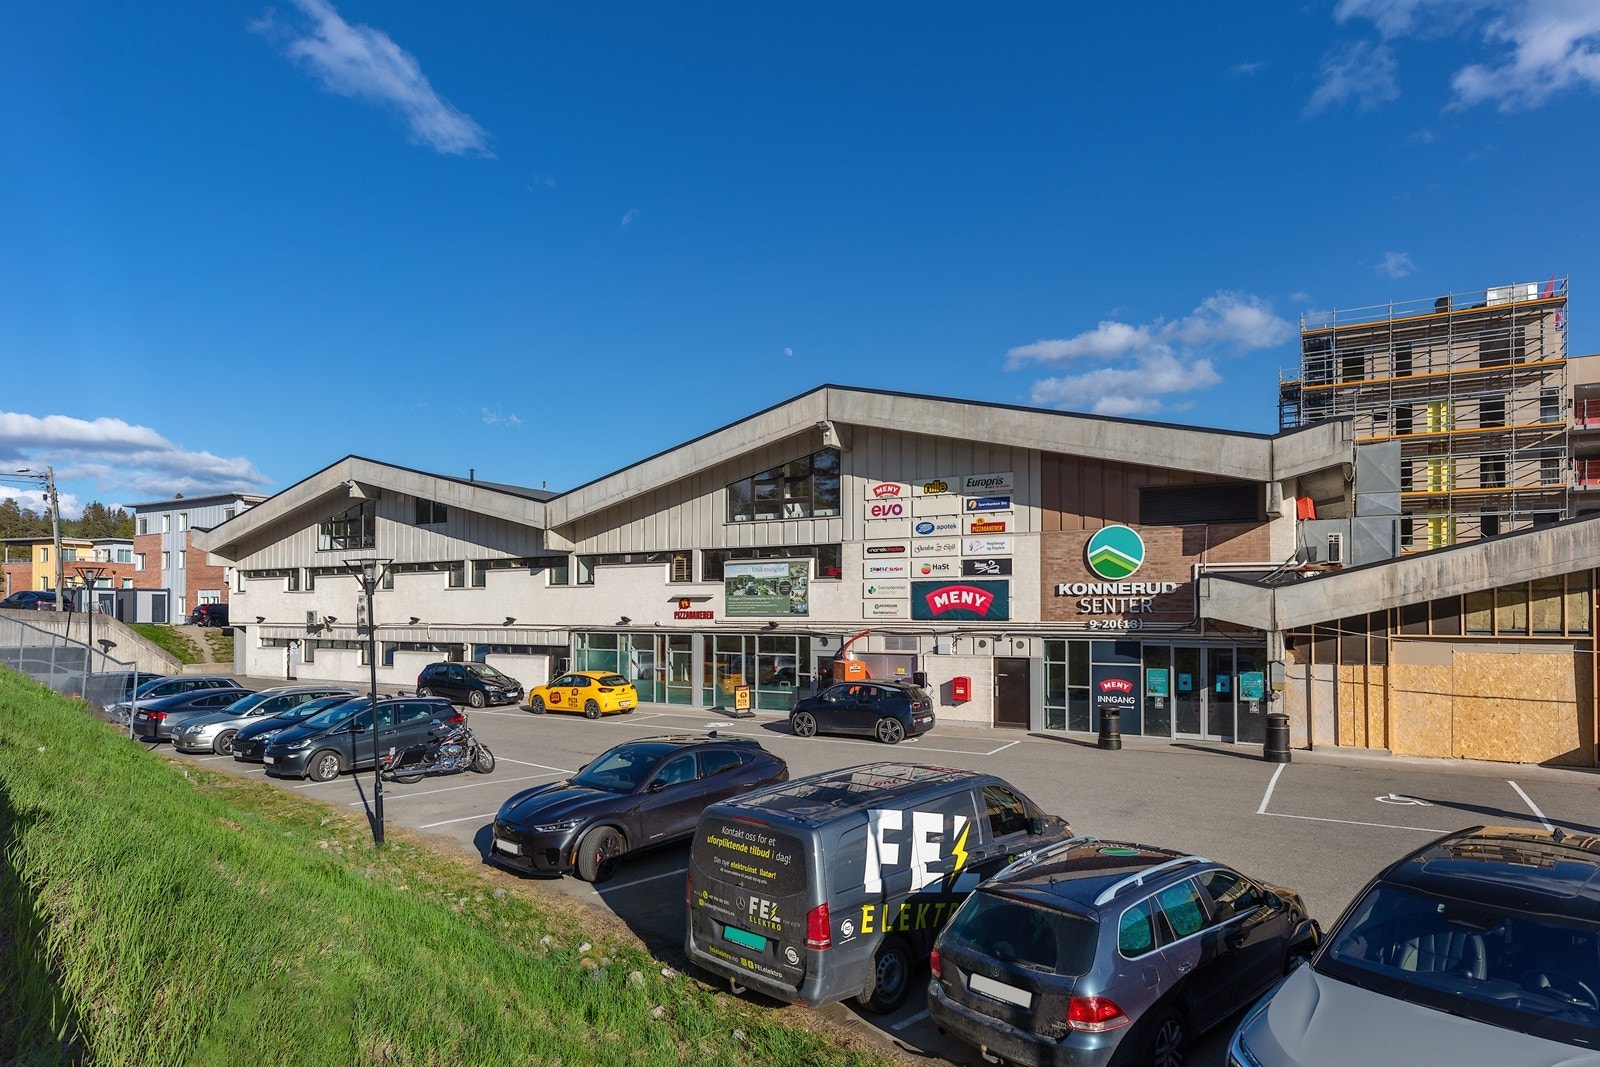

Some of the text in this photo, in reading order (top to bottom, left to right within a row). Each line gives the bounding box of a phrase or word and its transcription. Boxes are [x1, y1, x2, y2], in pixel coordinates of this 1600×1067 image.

[924, 480, 948, 494] nille
[966, 476, 1004, 488] Europris
[876, 486, 899, 495] MENY
[871, 503, 903, 517] evo
[1058, 582, 1177, 594] KONNERUD
[933, 591, 987, 608] MENY
[1080, 597, 1153, 613] SENTER
[1089, 619, 1144, 630] 9-20(18)
[1103, 681, 1129, 690] MENY
[1097, 695, 1135, 704] INNGANG
[721, 826, 776, 847] Kontakt oss for et
[707, 835, 748, 853] uforpliktende
[749, 845, 771, 859] tilbud
[775, 852, 792, 865] dag!
[713, 856, 722, 864] Din
[722, 859, 730, 867] nye
[730, 861, 777, 879] elektroinstllatør!
[749, 915, 782, 931] ELEKTRO
[860, 902, 961, 934] ELEKT
[754, 963, 783, 978] FELelektro
